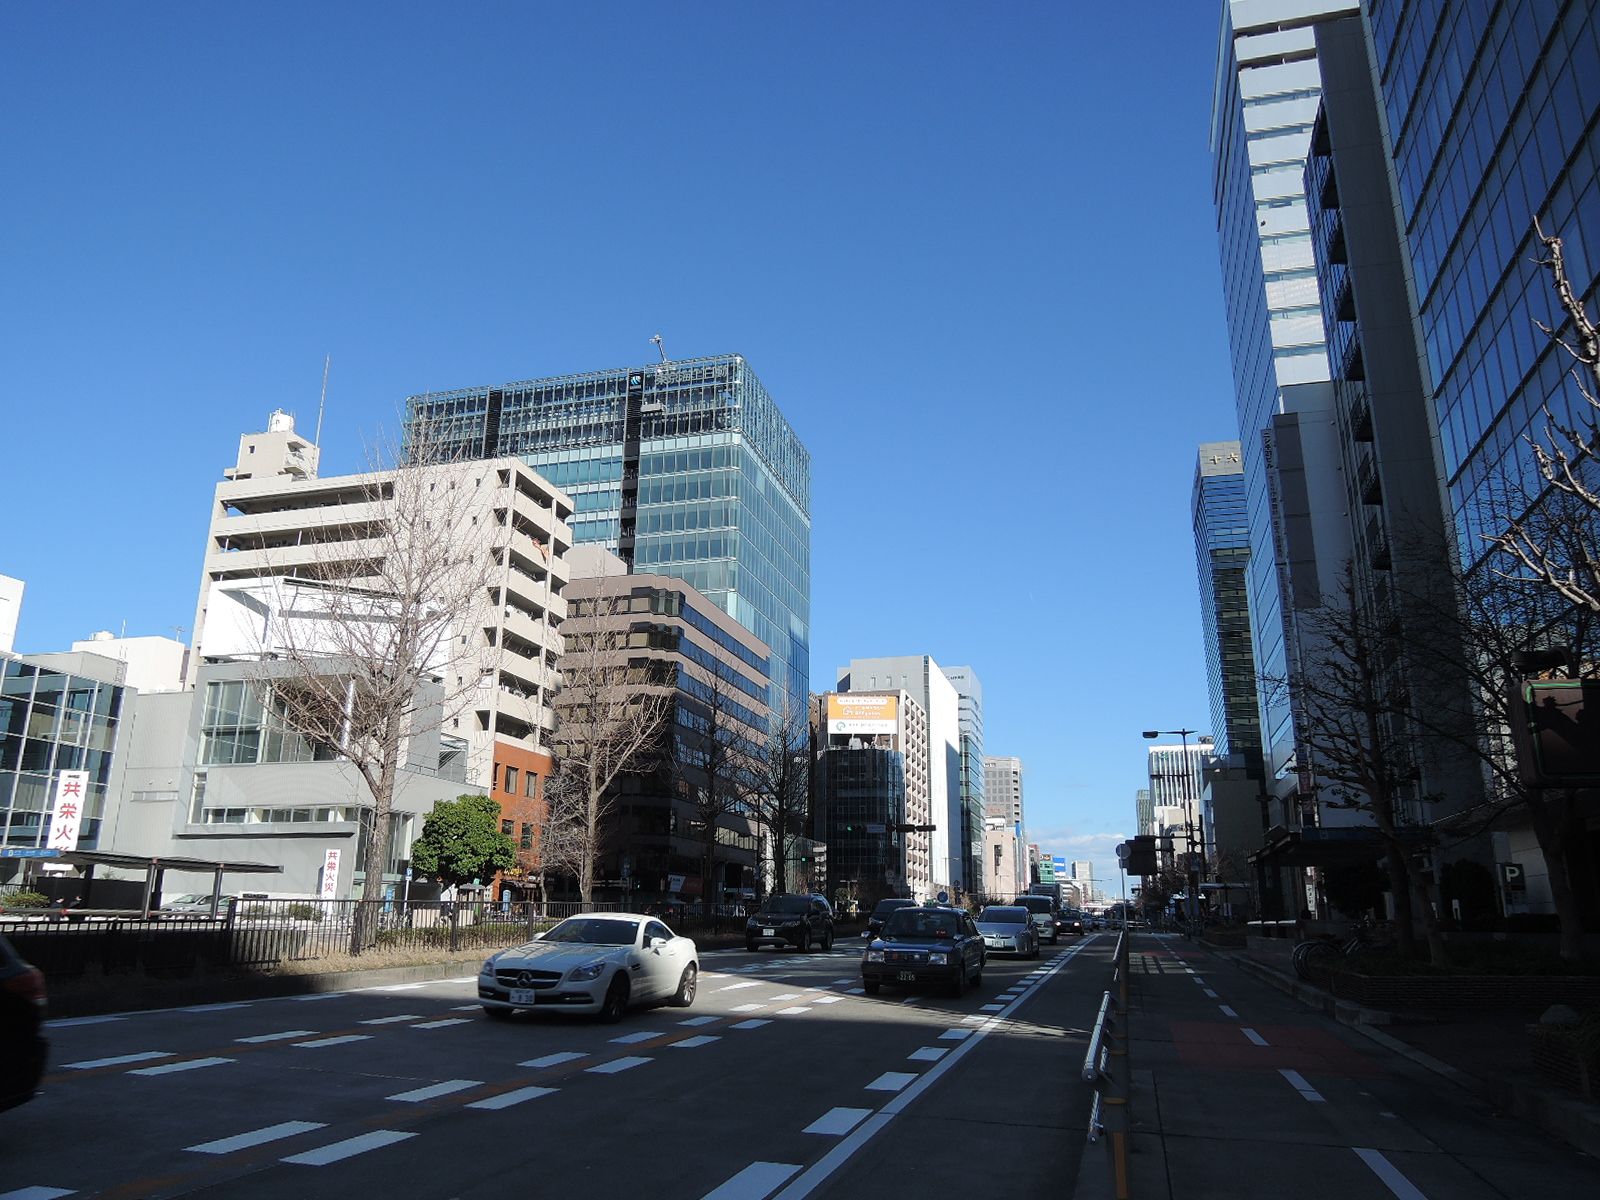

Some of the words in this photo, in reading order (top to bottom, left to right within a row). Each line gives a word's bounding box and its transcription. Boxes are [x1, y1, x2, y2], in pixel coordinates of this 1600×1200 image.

[324, 851, 338, 893] 共栄火災
[1505, 866, 1520, 882] P
